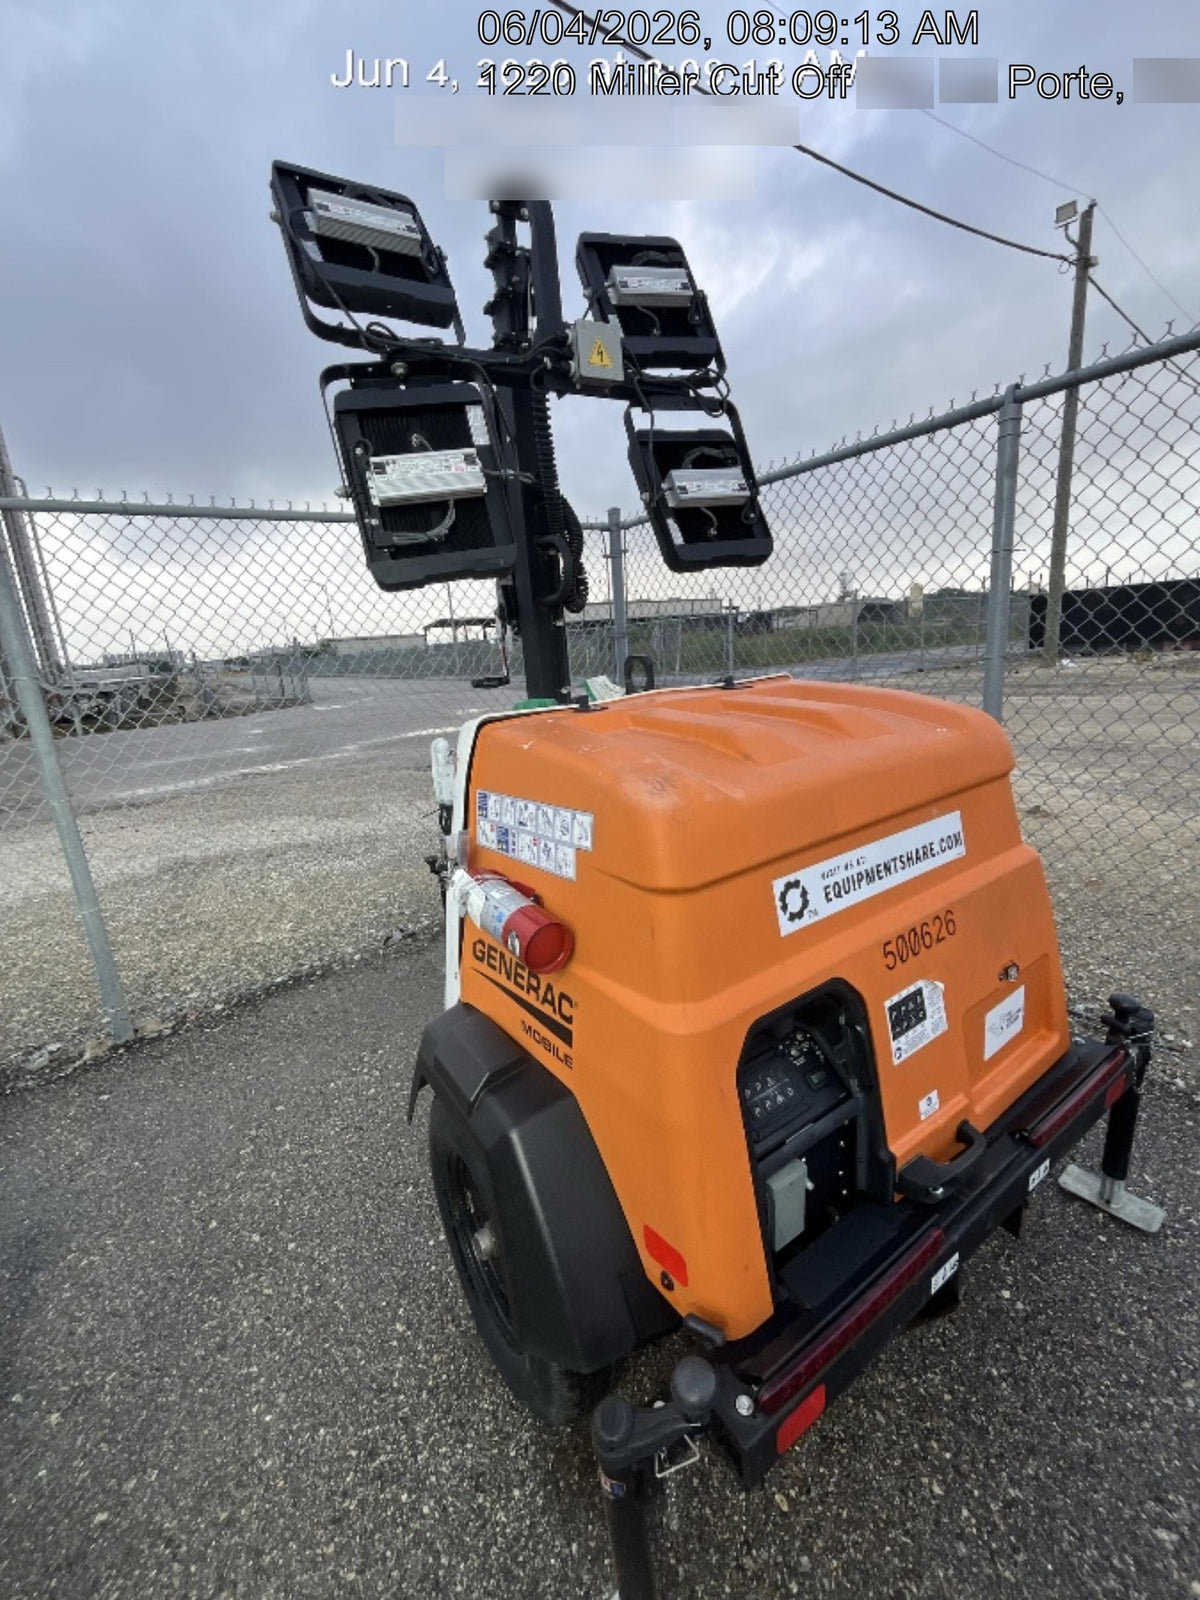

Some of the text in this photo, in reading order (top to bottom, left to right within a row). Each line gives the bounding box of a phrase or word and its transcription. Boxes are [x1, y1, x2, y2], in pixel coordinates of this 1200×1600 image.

[822, 830, 964, 904] EQUIPMENTSHARE.COM
[882, 909, 958, 972] 500626
[472, 937, 574, 1025] GENERAC
[521, 1019, 574, 1071] MOBILE
